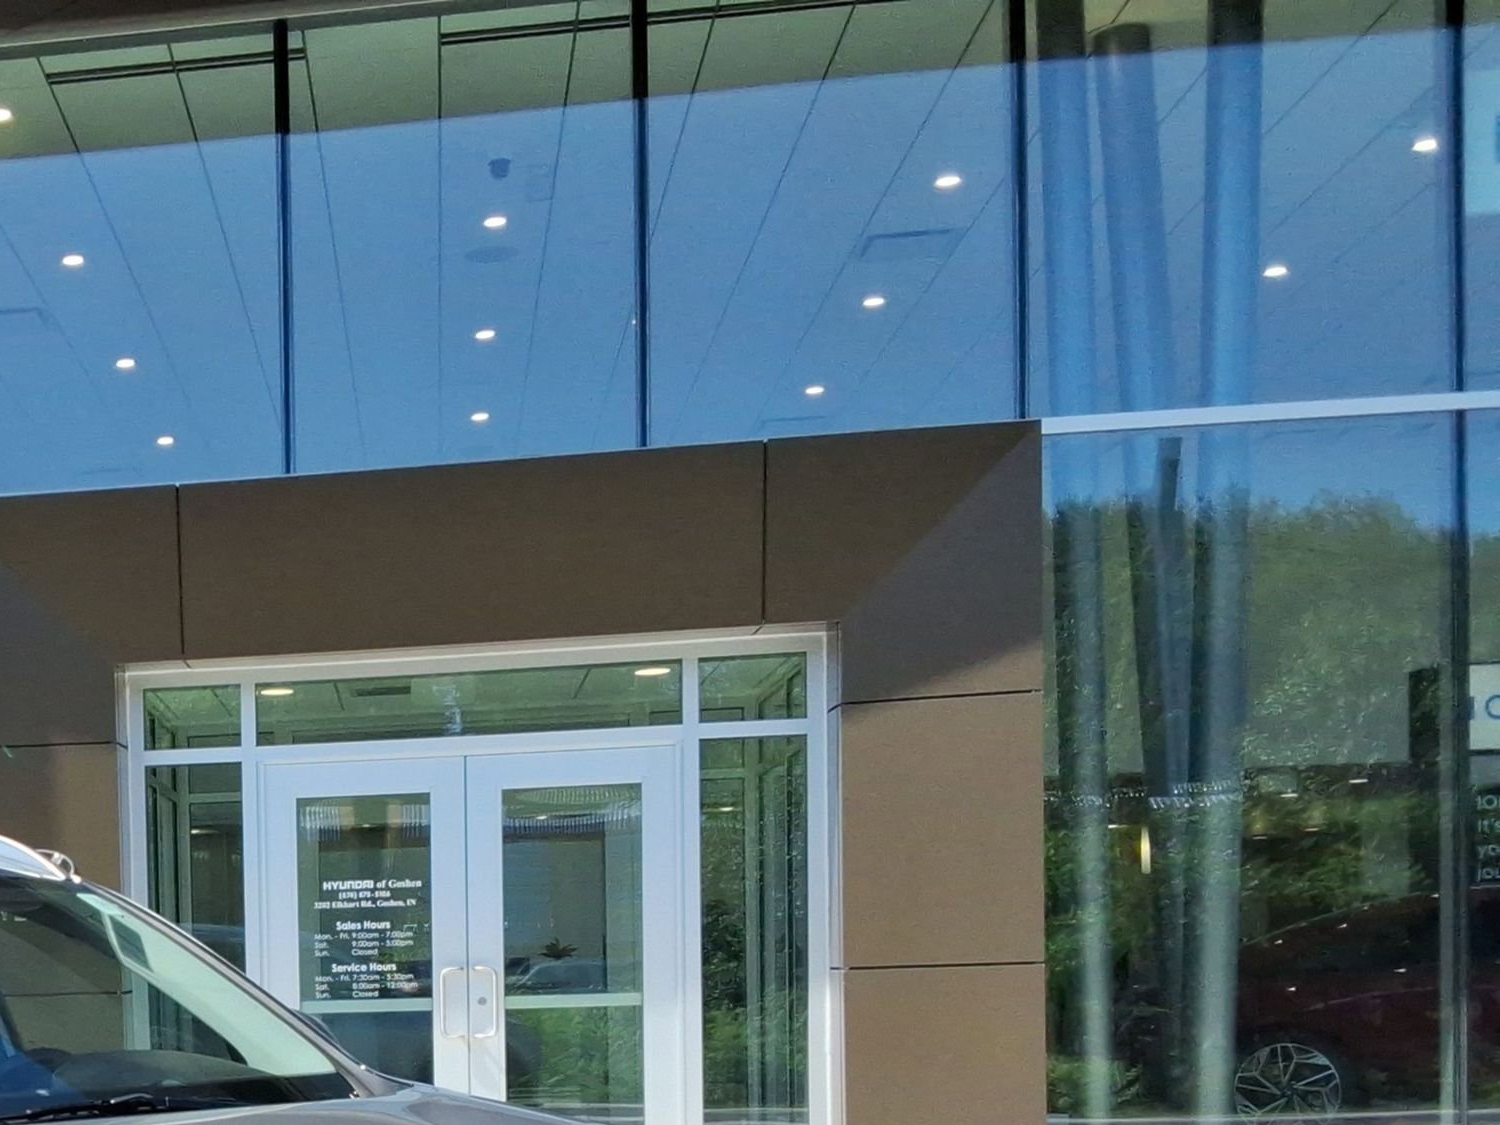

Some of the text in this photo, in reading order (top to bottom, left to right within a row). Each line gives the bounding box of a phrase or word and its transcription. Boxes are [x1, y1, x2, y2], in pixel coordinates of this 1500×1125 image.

[323, 879, 422, 891] HYUNDAI of Goshen
[336, 920, 391, 931] Sales Hours
[351, 948, 378, 956] Closed
[331, 963, 397, 973] Service Hours
[352, 990, 379, 998] Closed
